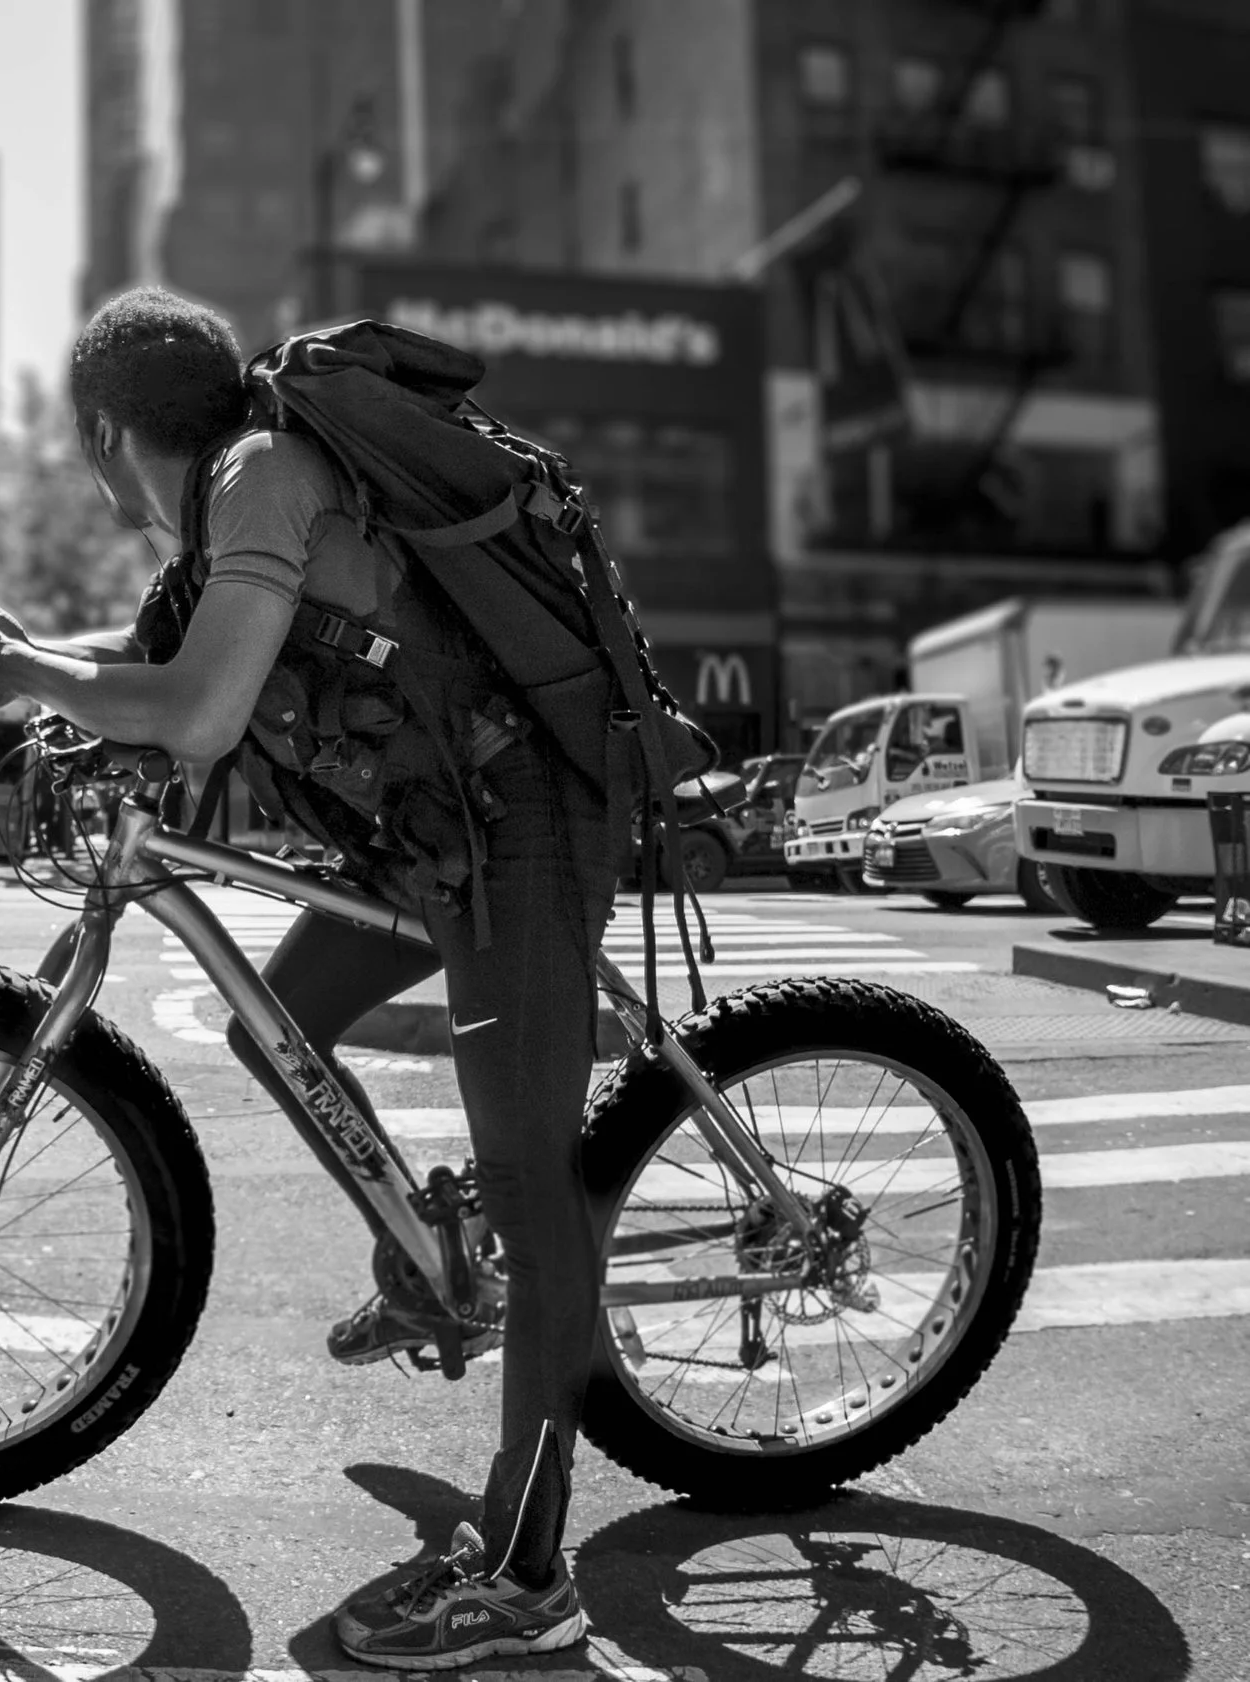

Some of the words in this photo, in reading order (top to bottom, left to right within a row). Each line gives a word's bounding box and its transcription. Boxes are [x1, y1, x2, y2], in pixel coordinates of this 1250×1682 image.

[7, 1057, 46, 1108] FRAMED
[307, 1078, 377, 1161] FRAMED
[70, 1362, 141, 1434] FRAMED
[450, 1609, 491, 1630] FILA
